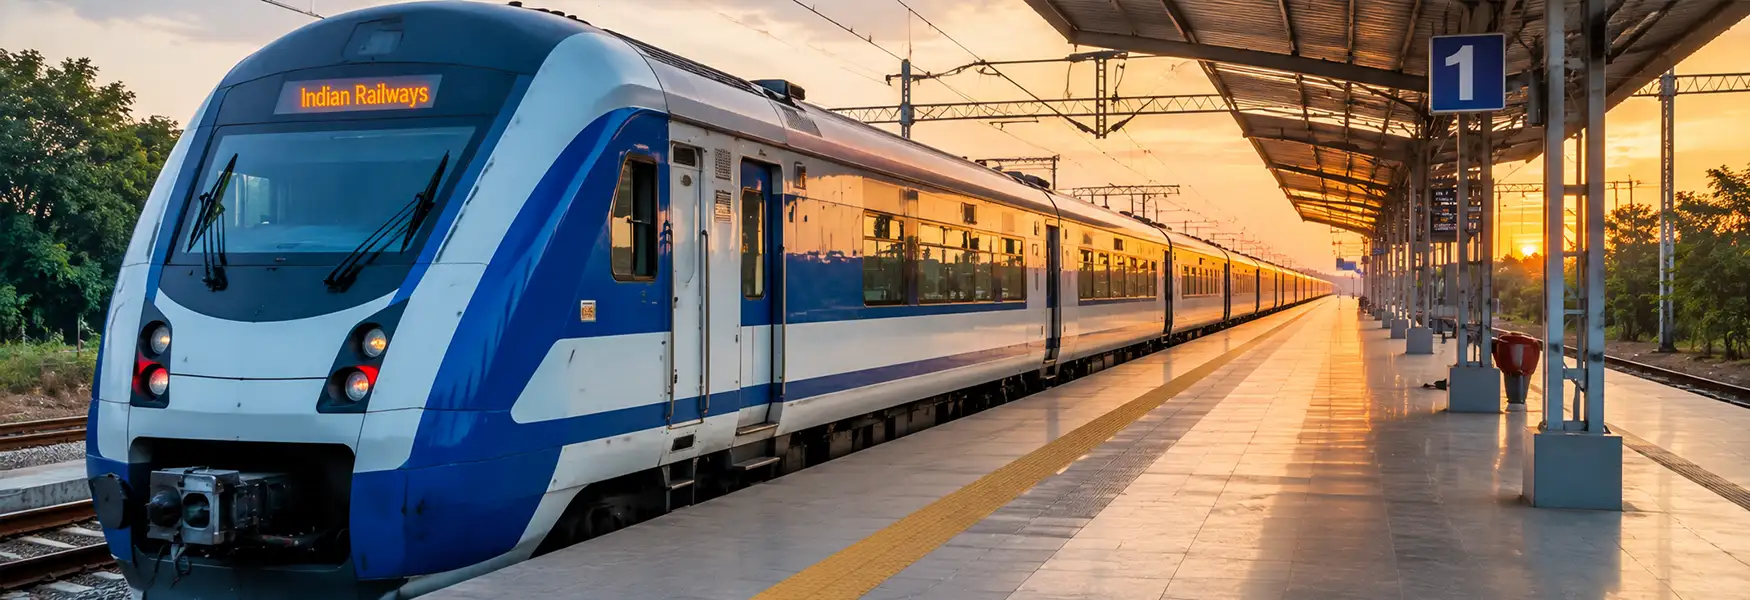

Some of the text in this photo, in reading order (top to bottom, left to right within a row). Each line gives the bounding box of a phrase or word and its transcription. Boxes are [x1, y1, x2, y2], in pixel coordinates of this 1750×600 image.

[1445, 45, 1473, 101] 1
[301, 83, 428, 108] Indian Railways
